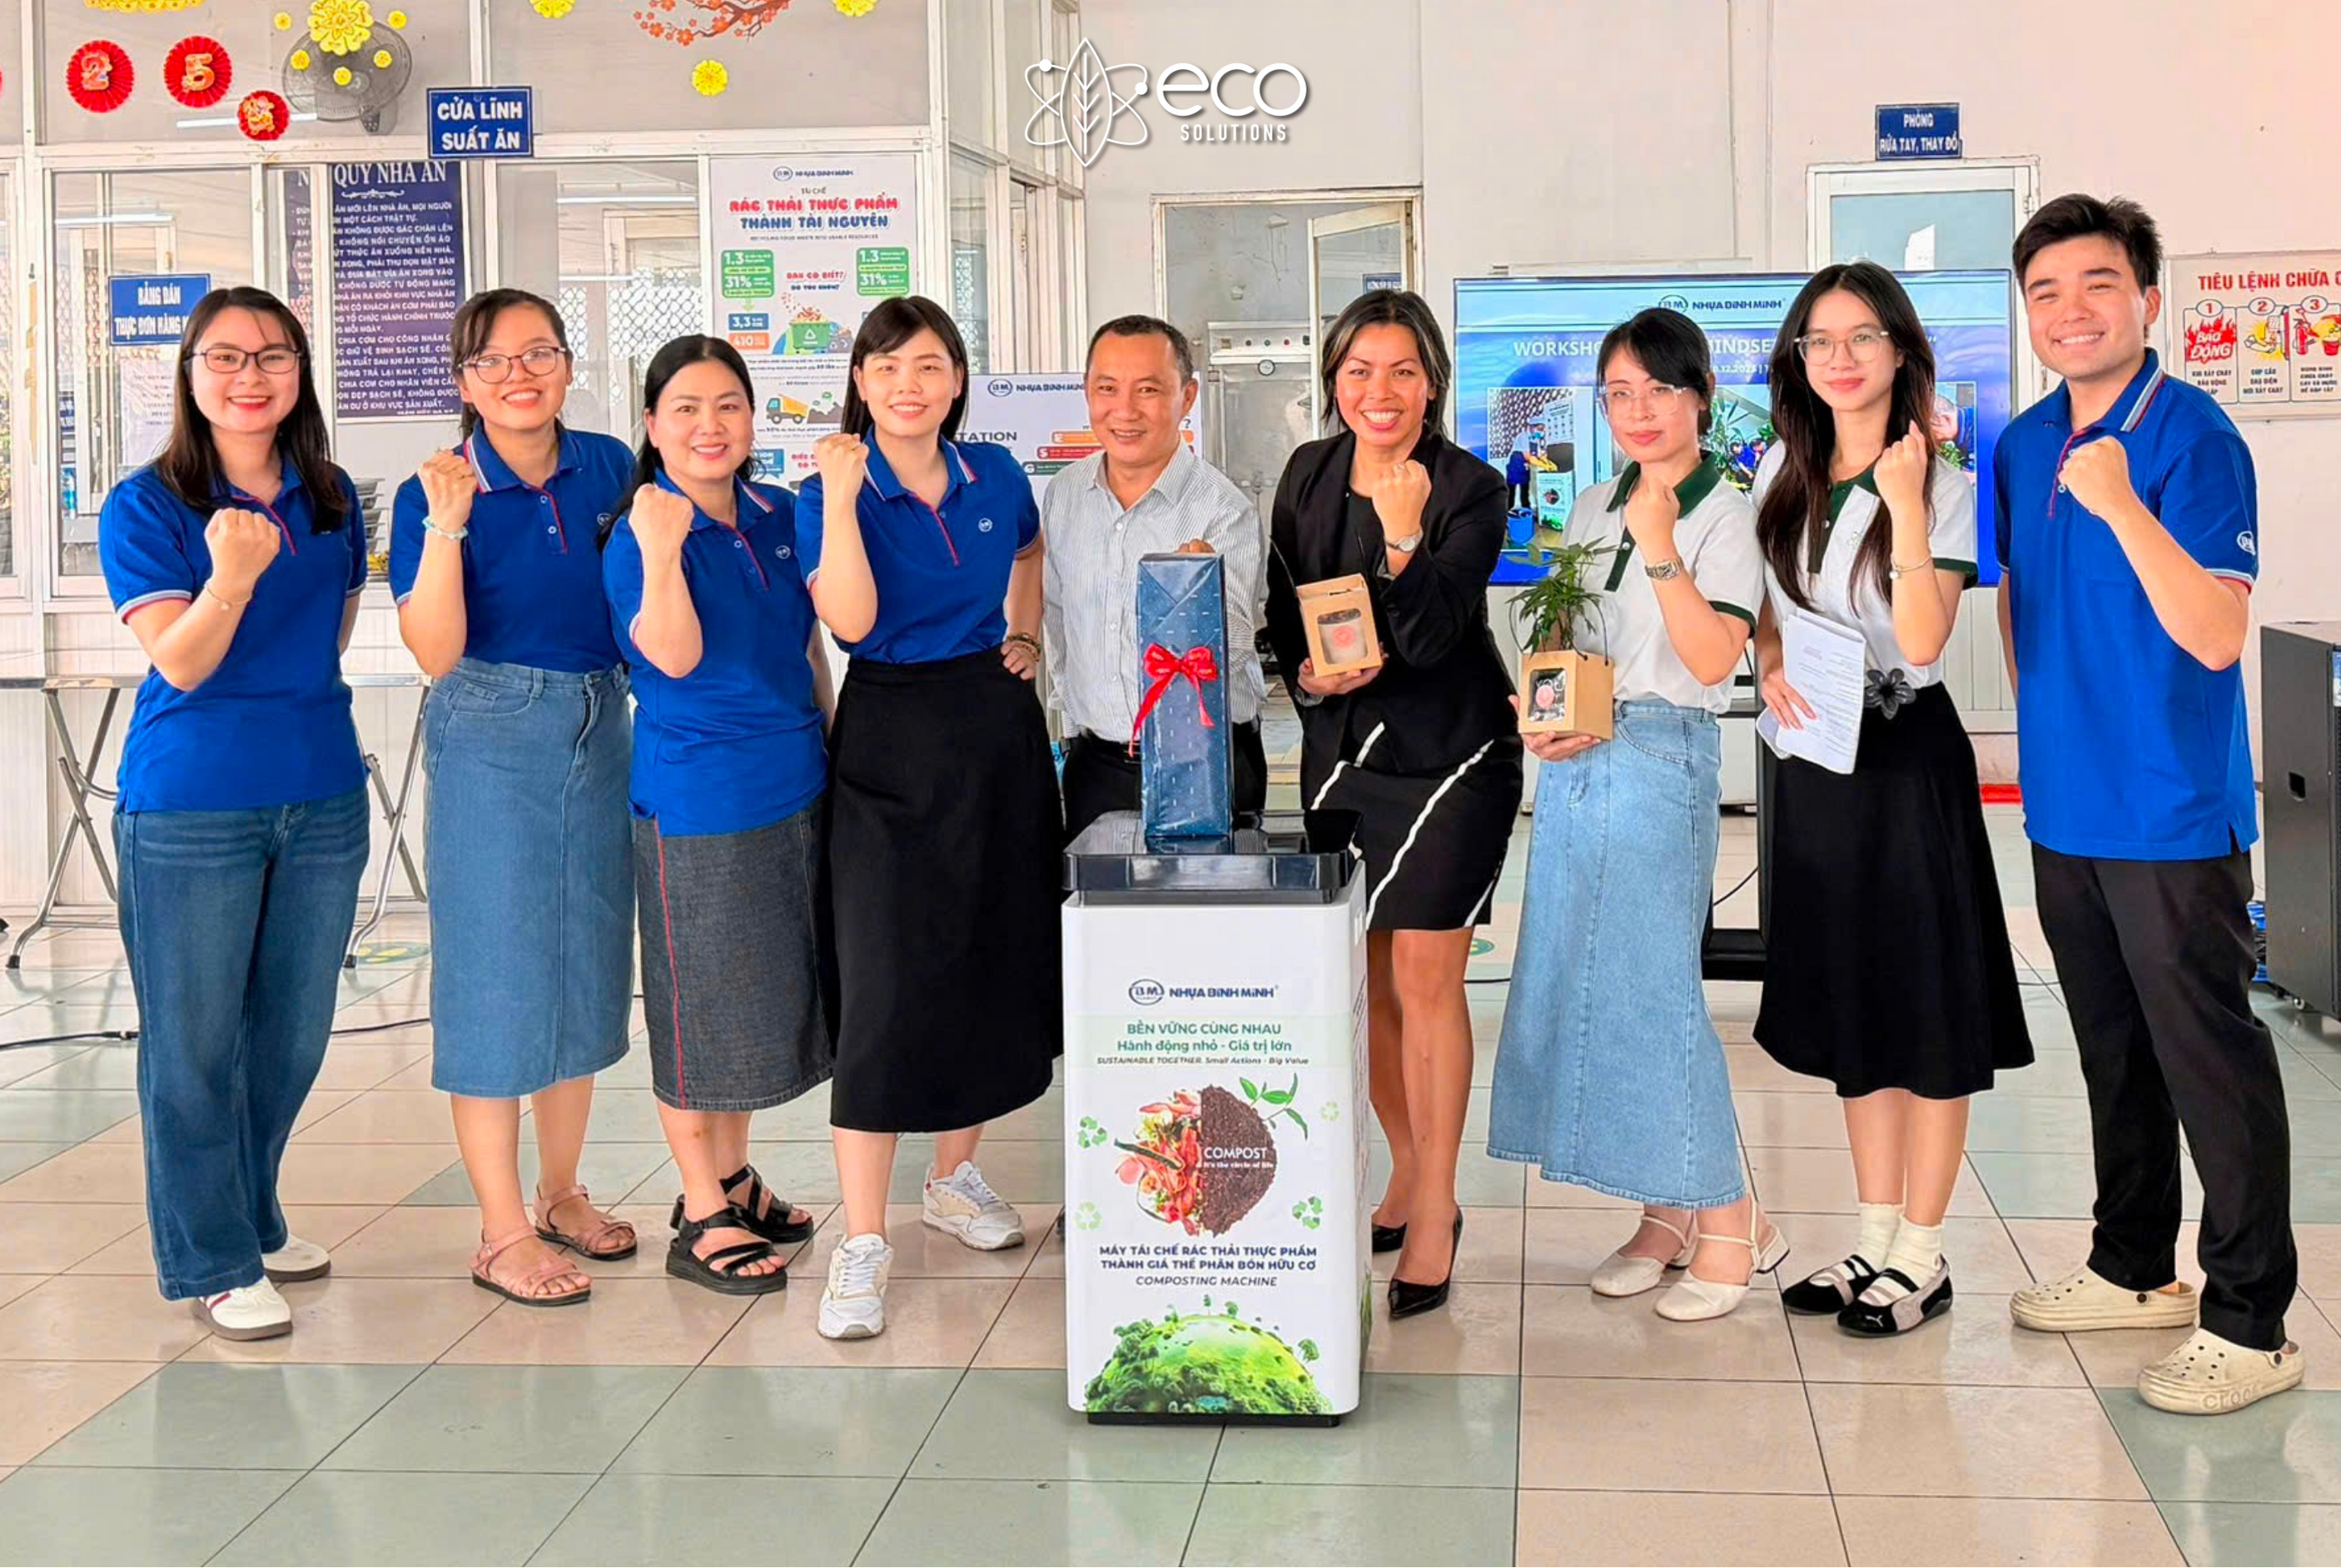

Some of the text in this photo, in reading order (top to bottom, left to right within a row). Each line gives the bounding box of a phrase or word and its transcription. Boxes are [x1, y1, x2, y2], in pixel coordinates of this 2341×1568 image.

[82, 50, 215, 92] 2 5
[437, 96, 523, 120] CỬA LĨNH
[441, 125, 520, 150] SUẤT ĂN
[1899, 137, 1919, 153] TAY,
[1921, 136, 1944, 151] THAY
[729, 191, 898, 212] RÁC THẢI THỰC PHẨM
[740, 211, 888, 230] THÀNH TÀI NGUYÊN
[723, 251, 743, 265] 1.3
[859, 250, 878, 262] 1.3
[725, 275, 753, 288] 31%
[859, 273, 887, 285] 31%
[2198, 272, 2233, 290] TIÊU
[2239, 270, 2279, 292] LỆNH
[2286, 268, 2329, 287] CHỮA
[2206, 303, 2213, 314] 1
[2257, 301, 2267, 312] 2
[2309, 300, 2320, 310] 3
[1513, 340, 1773, 356] WORKSHO INDSE
[2190, 343, 2232, 360] ĐỘNG
[1016, 385, 1041, 394] NHỰA
[957, 431, 1017, 442] TATION
[1169, 988, 1205, 1000] NHỰA
[1127, 1020, 1281, 1035] BỀN VỮNG CÙNG NHAU
[1117, 1040, 1153, 1051] Hành
[1155, 1040, 1189, 1054] động
[1192, 1040, 1218, 1051] nhỏ
[1228, 1040, 1250, 1052] Giá
[1252, 1040, 1268, 1054] trị
[1270, 1040, 1292, 1052] lớn
[1096, 1056, 1155, 1064] SUSTAINABLE
[1205, 1056, 1228, 1064] Small
[1230, 1056, 1262, 1064] Actions
[1268, 1057, 1283, 1065] Big
[1204, 1147, 1267, 1160] COMPOST
[1100, 1243, 1127, 1256] MÁY
[1130, 1243, 1151, 1256] TÁI
[1154, 1242, 1180, 1256] CHẾ
[1182, 1243, 1208, 1256] RÁC
[1210, 1243, 1240, 1256] THẢI
[1244, 1244, 1276, 1258] THỰC
[1101, 1258, 1144, 1269] THÀNH
[1146, 1258, 1169, 1269] GIÁ
[1199, 1258, 1234, 1269] PHÂN
[1237, 1258, 1265, 1270] BÓN
[1268, 1258, 1295, 1270] HỮU
[1297, 1258, 1317, 1270] CƠ
[1136, 1276, 1278, 1286] COMPOSTING MACHINE
